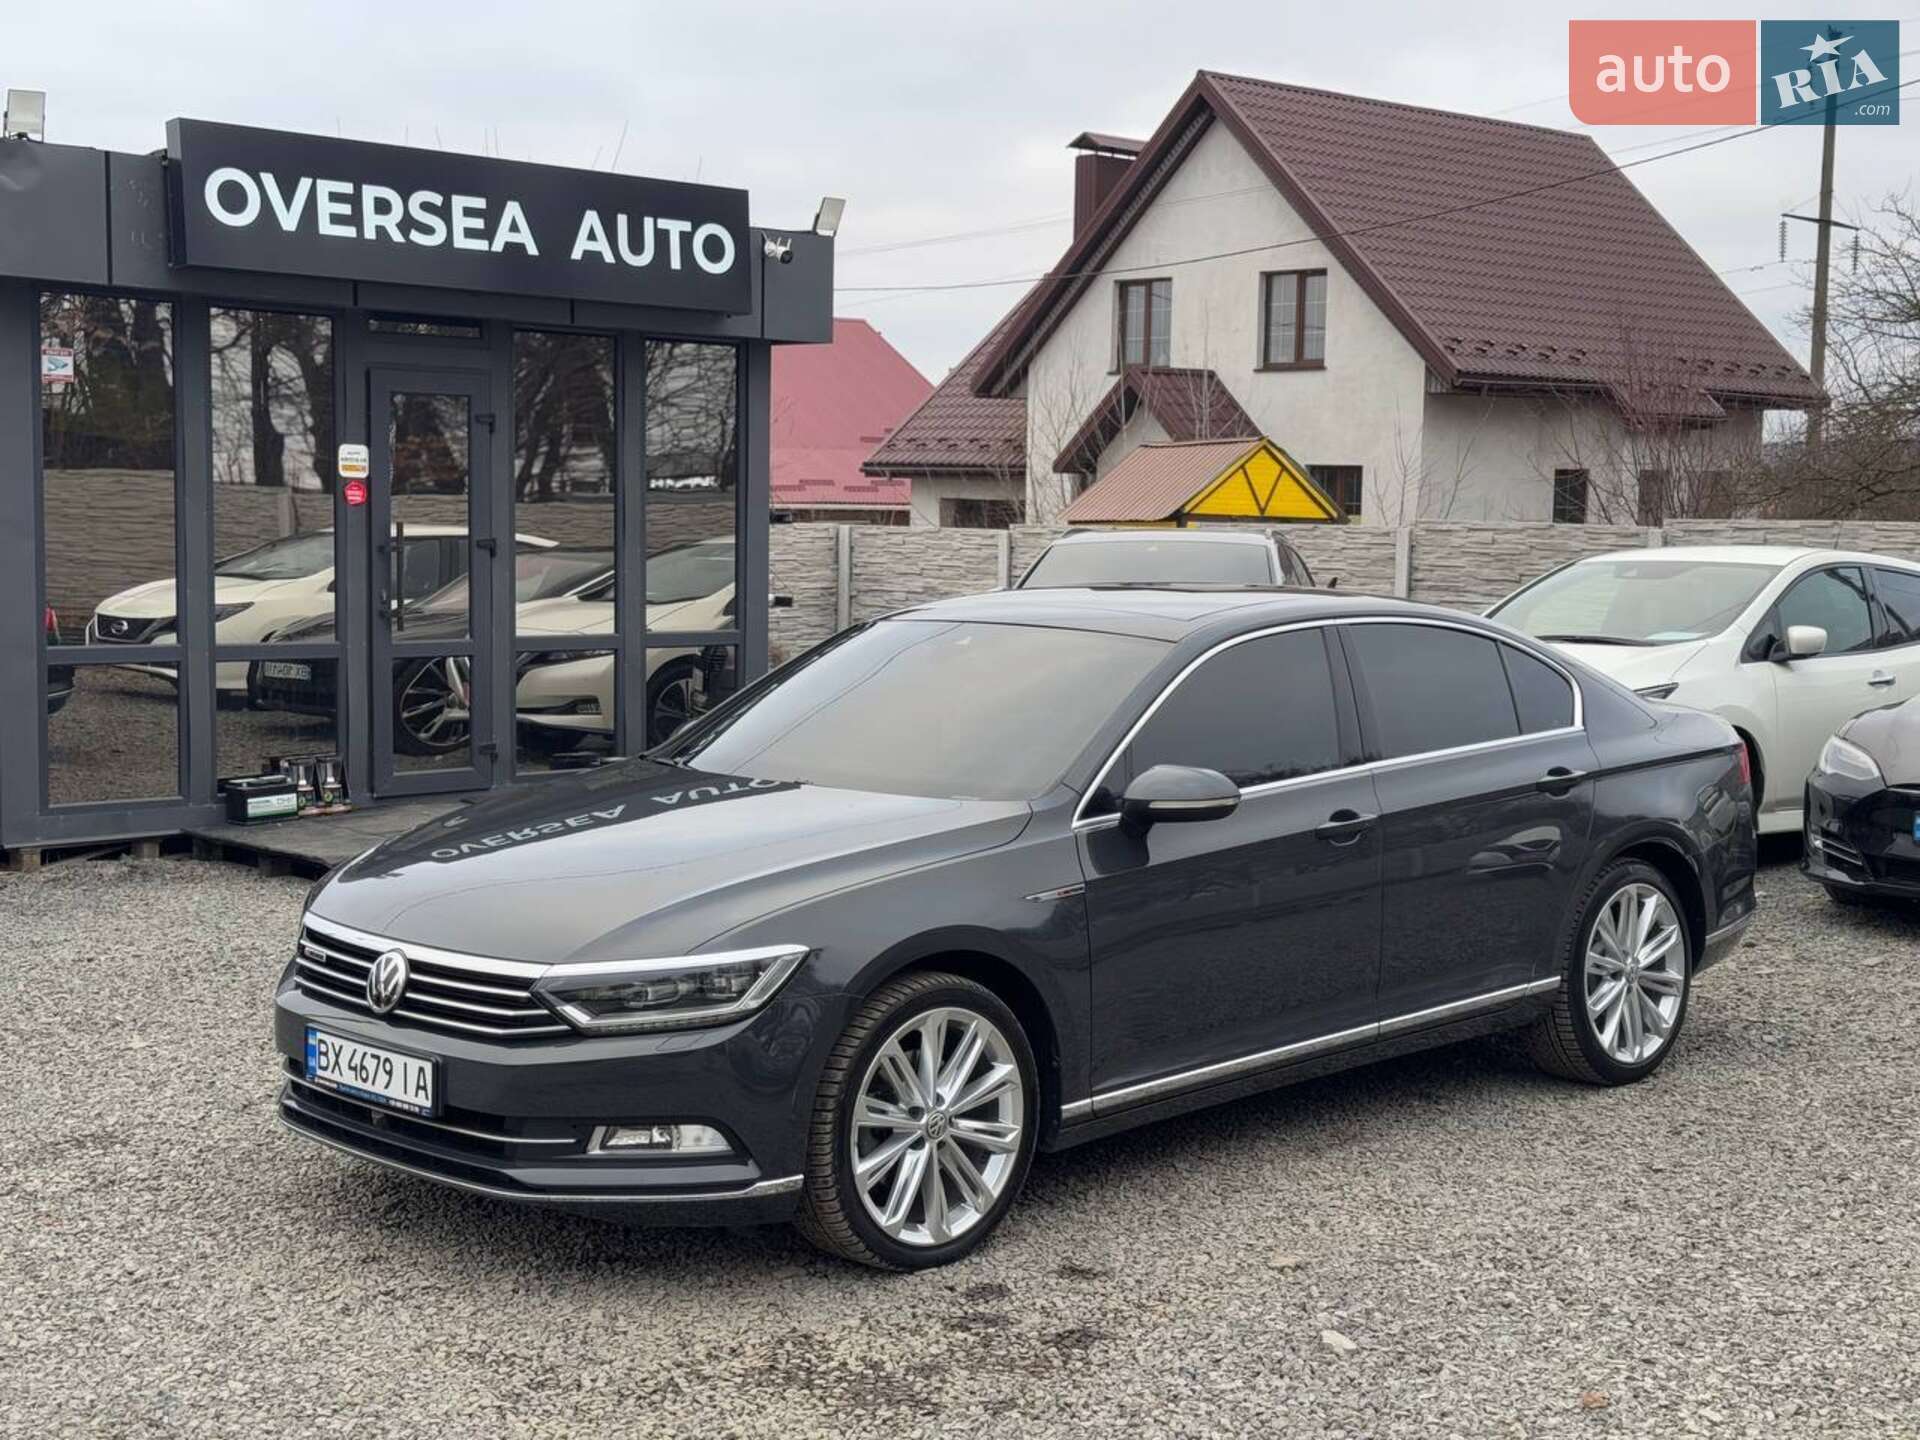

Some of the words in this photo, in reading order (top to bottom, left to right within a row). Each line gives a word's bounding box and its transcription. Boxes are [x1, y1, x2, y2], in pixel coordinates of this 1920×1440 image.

[203, 166, 539, 256] OVERSEA
[570, 209, 736, 275] AUTO
[317, 1039, 343, 1077] BX
[348, 1048, 394, 1090] 4679
[403, 1061, 429, 1101] IA
